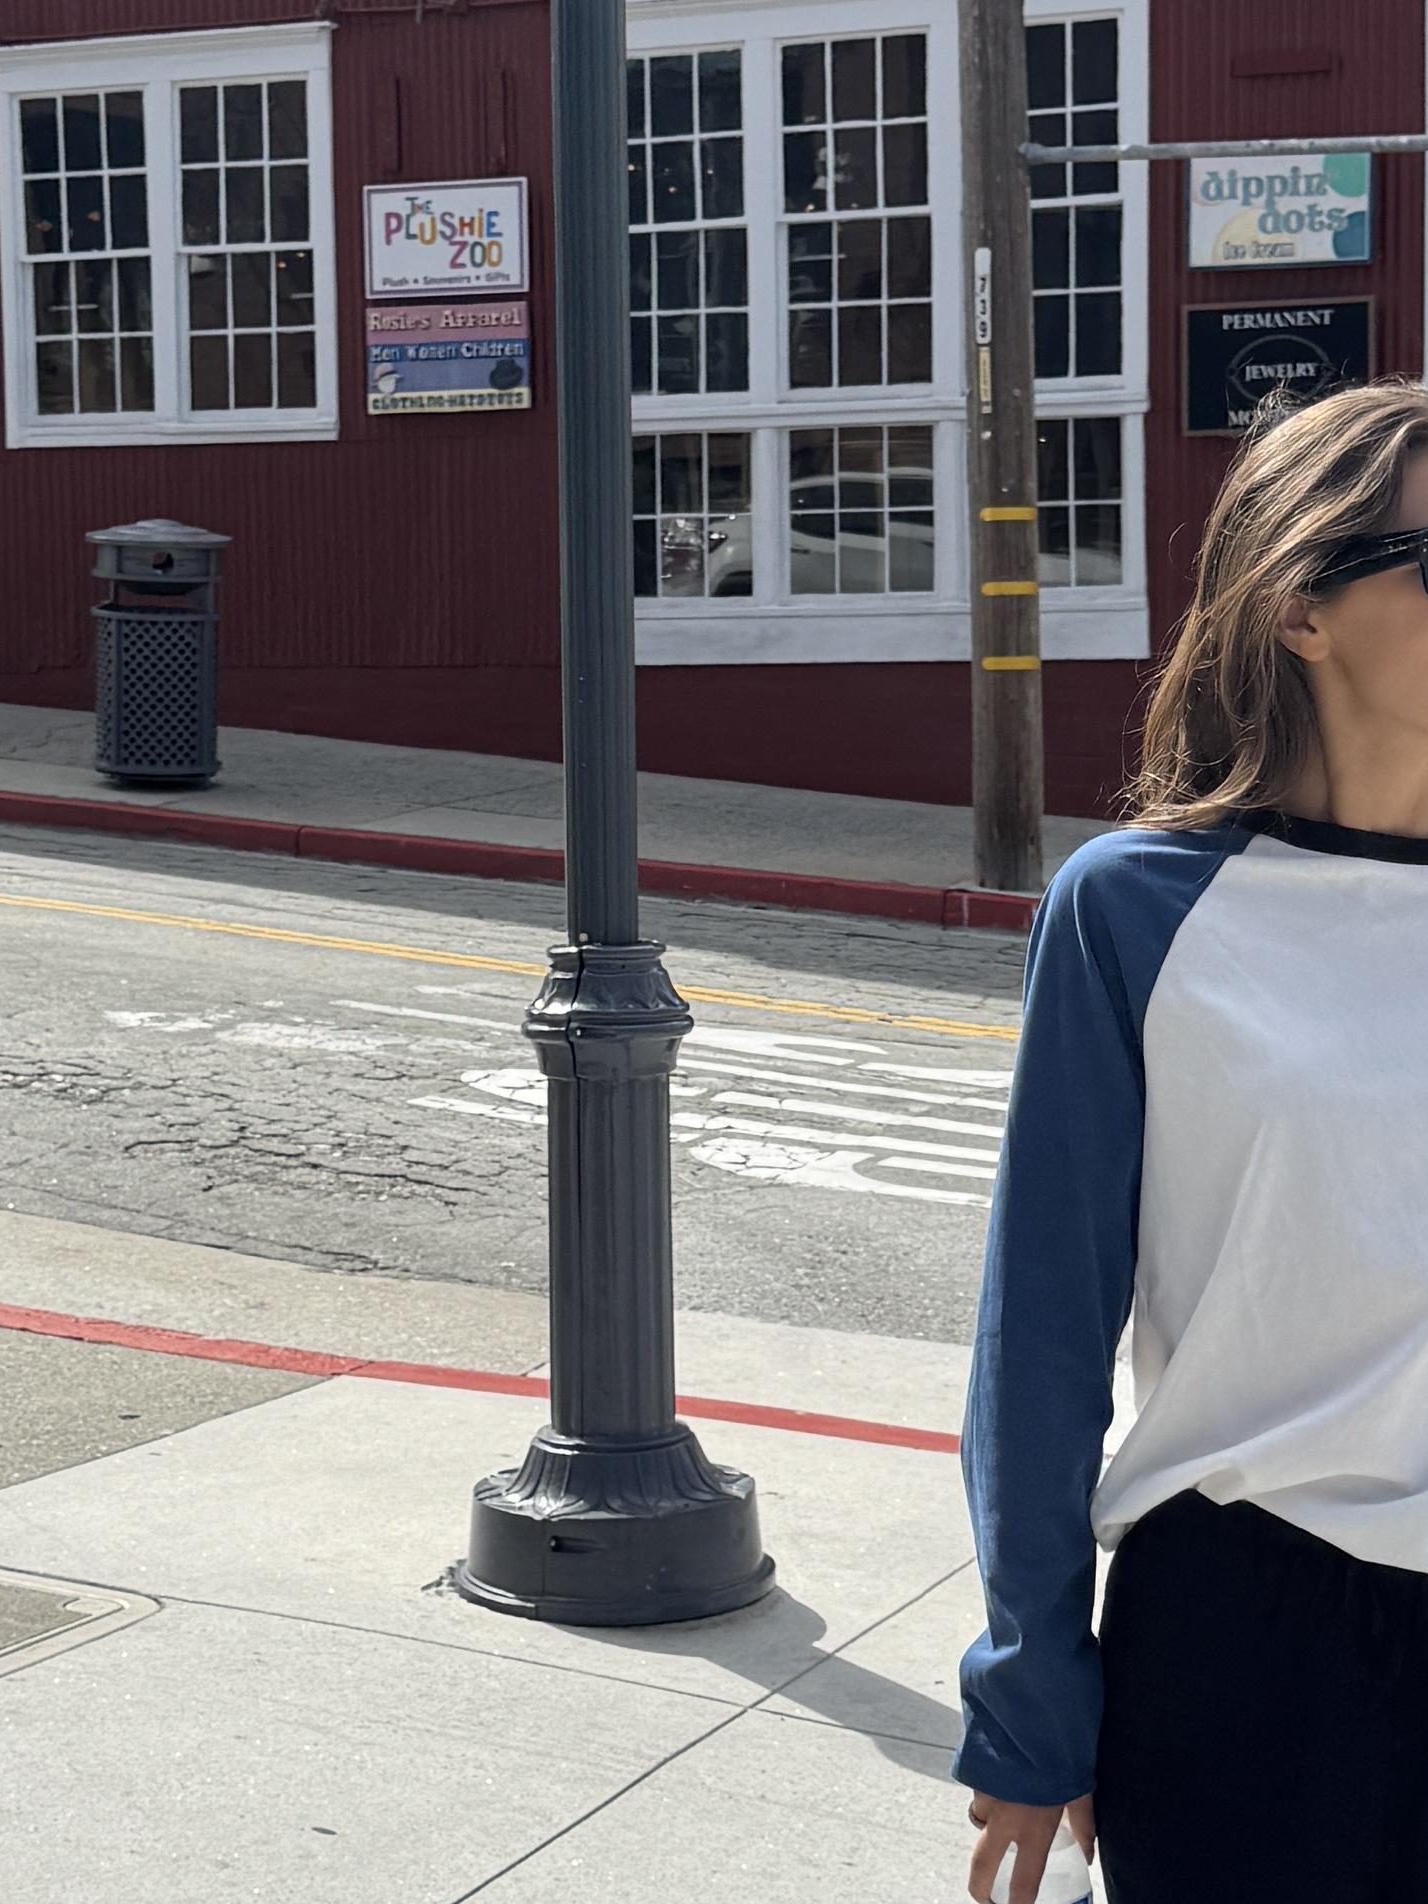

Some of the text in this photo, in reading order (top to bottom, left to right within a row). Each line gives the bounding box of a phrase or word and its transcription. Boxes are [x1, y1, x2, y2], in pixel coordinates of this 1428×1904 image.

[384, 208, 504, 246] PLUSHIE
[1257, 202, 1348, 236] dots
[447, 240, 503, 270] ZOO
[439, 307, 521, 329] Apparel
[1222, 309, 1334, 331] PERMANENT
[460, 341, 525, 359] Children
[1245, 362, 1320, 383] JEWELRY
